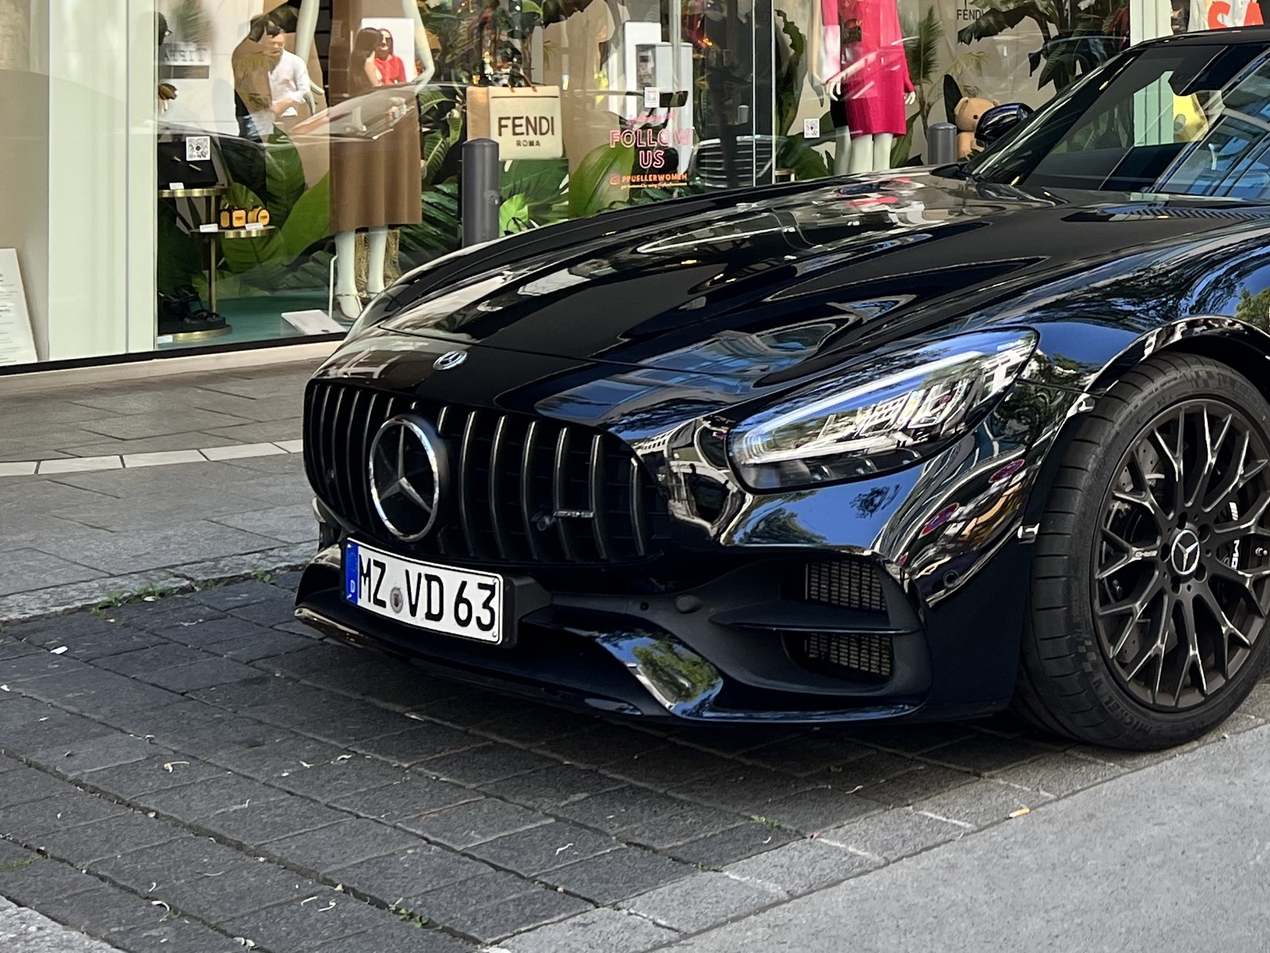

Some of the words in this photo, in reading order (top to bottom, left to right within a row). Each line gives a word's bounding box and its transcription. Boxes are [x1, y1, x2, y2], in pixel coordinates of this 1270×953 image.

[498, 116, 555, 137] FENDI
[609, 129, 694, 148] FOLLOW
[639, 150, 665, 169] US
[358, 554, 387, 609] MZ
[405, 569, 444, 622] VD
[453, 580, 497, 632] 63
